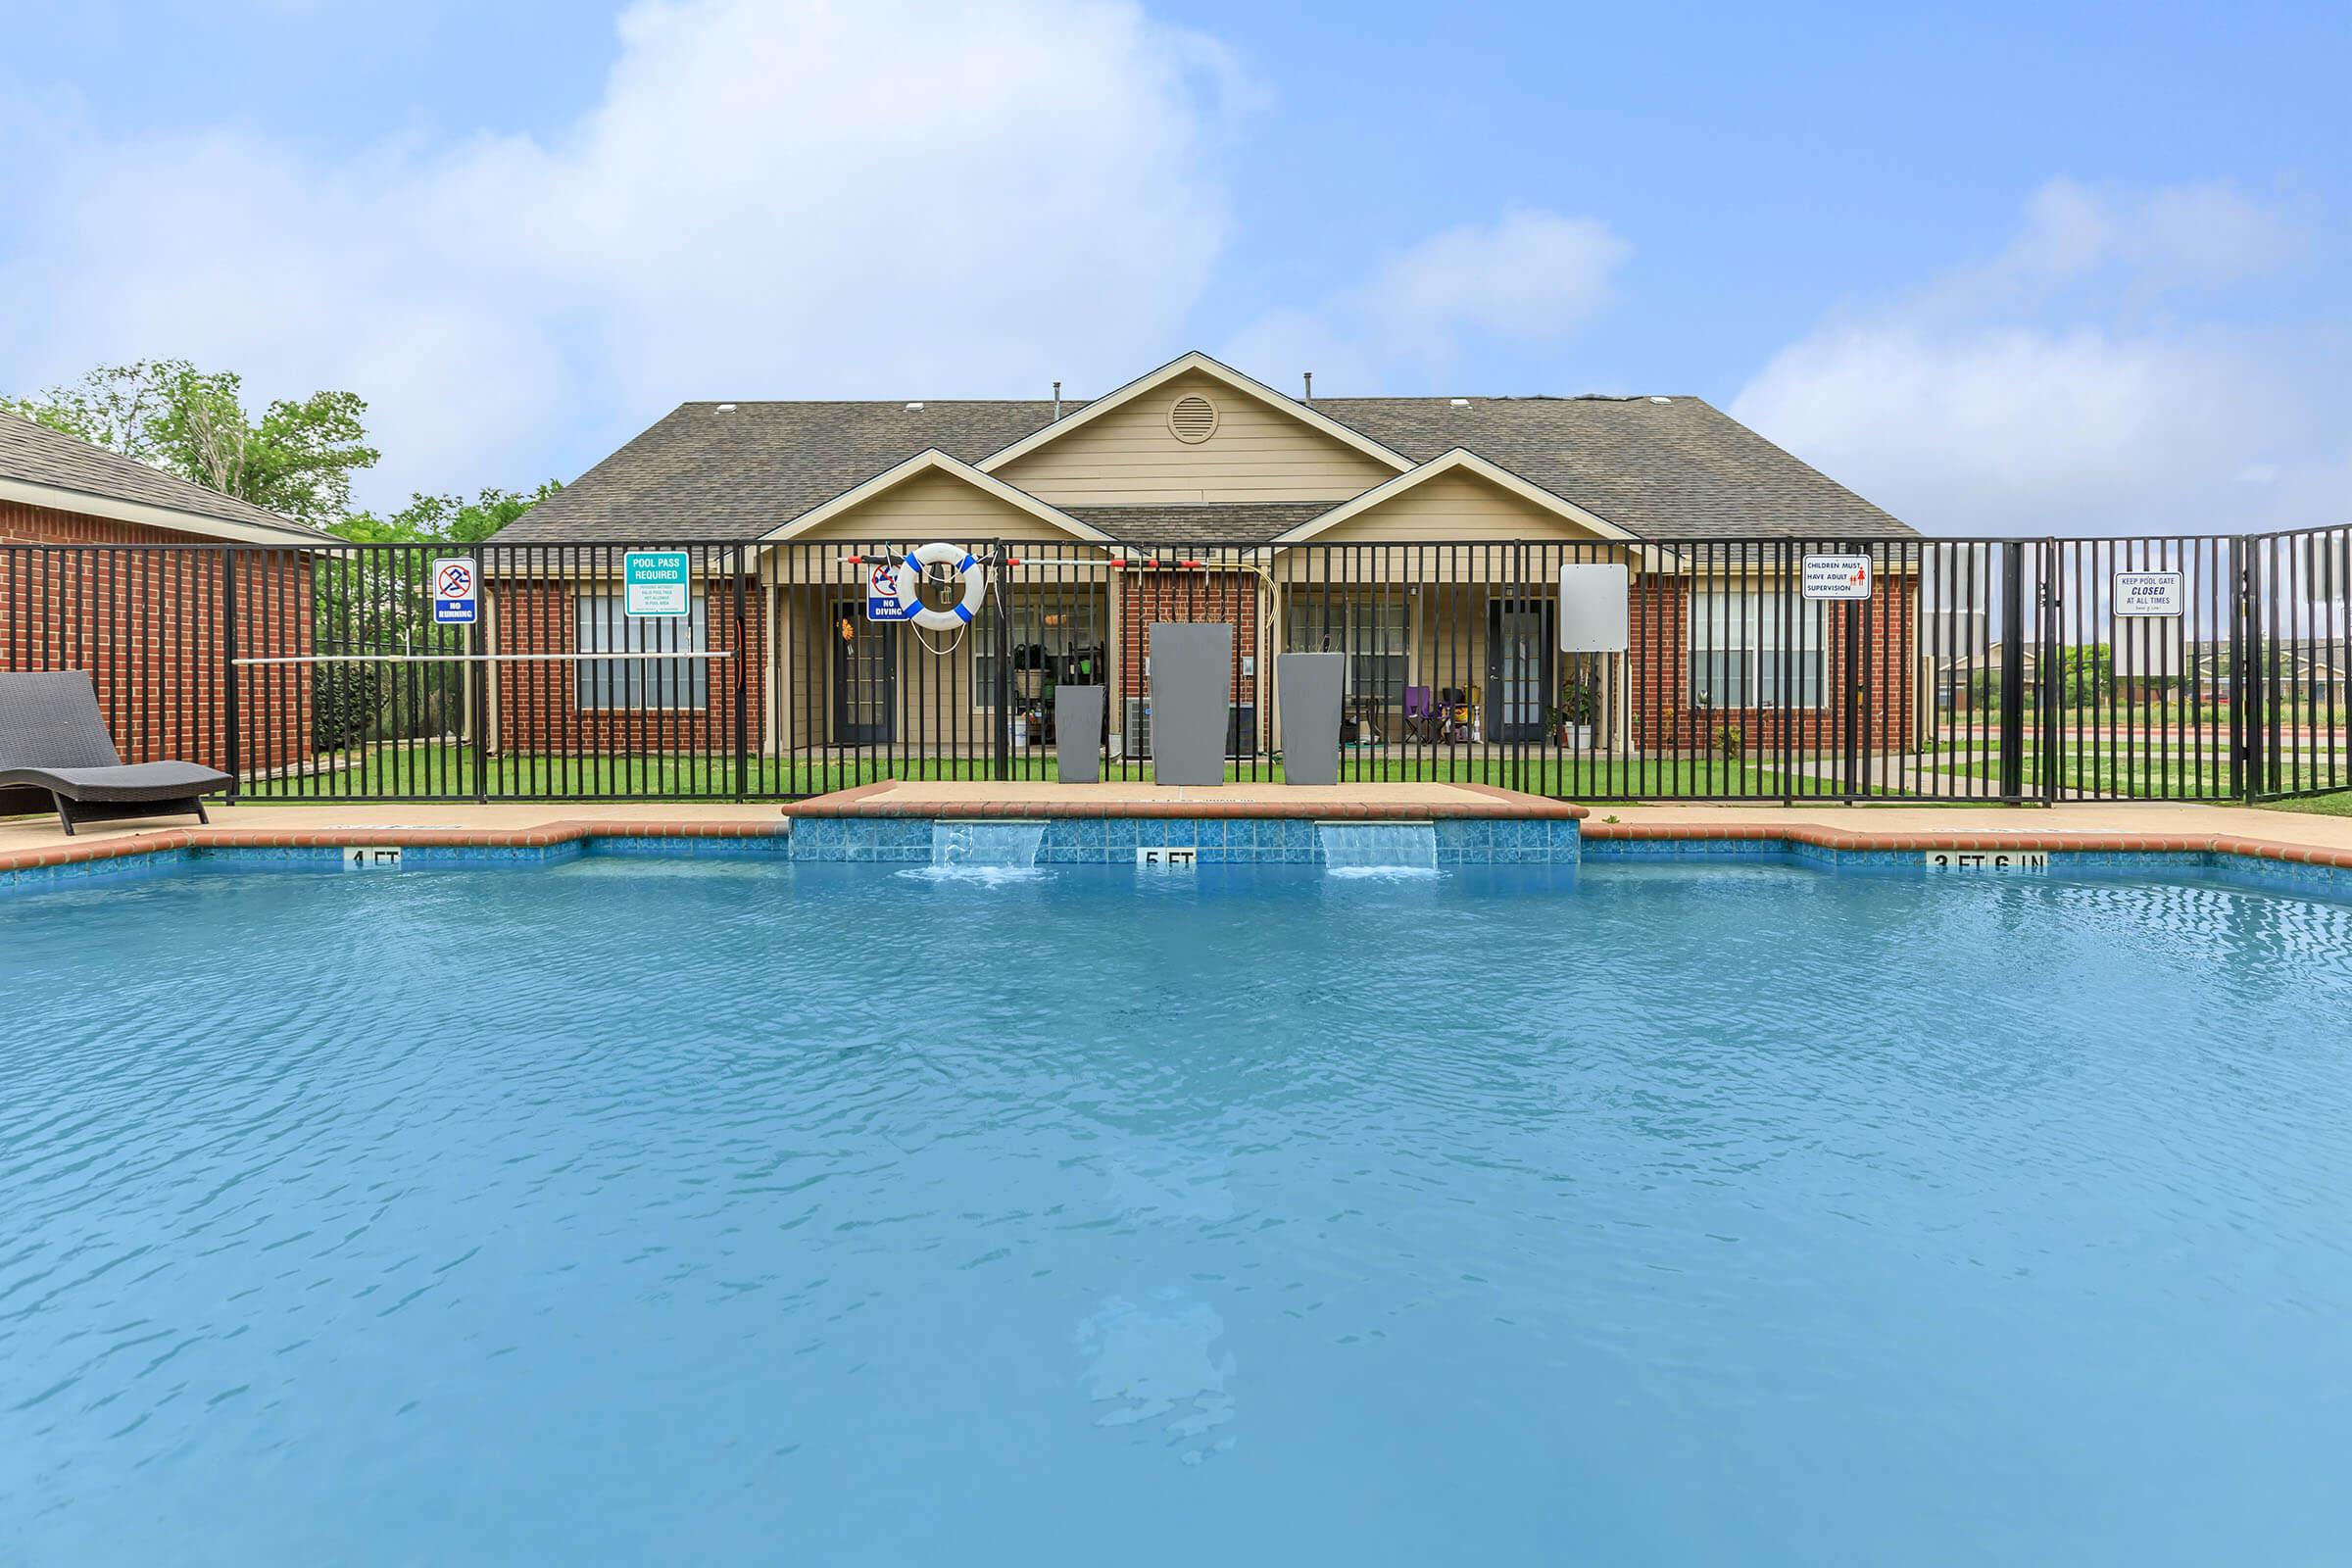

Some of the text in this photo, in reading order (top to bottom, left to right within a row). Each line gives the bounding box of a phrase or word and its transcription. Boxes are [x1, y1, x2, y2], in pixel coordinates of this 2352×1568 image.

[633, 558, 680, 567] POOL PASS
[635, 570, 678, 579] REQUIRED
[1147, 852, 1194, 868] 5 FT
[1958, 855, 1984, 869] FT
[2022, 855, 2044, 871] IN
